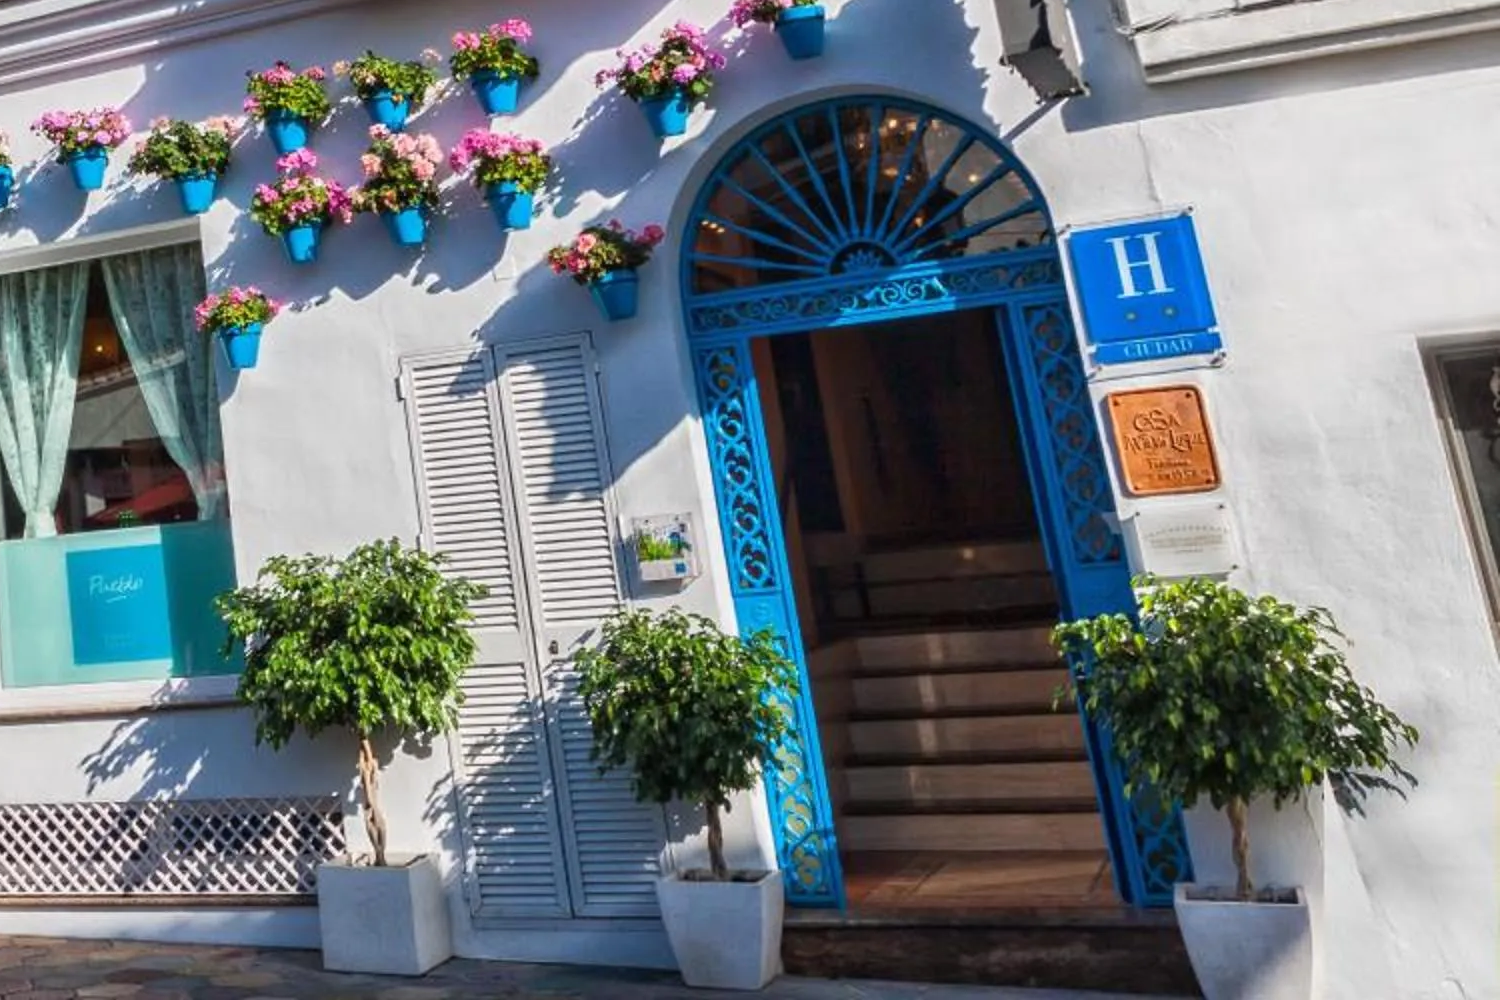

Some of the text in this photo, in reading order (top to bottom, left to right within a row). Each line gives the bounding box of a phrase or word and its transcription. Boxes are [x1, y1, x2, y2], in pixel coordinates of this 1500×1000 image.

[1104, 231, 1175, 299] H
[1123, 338, 1194, 358] CIUDAD
[88, 573, 144, 600] Pueblo
